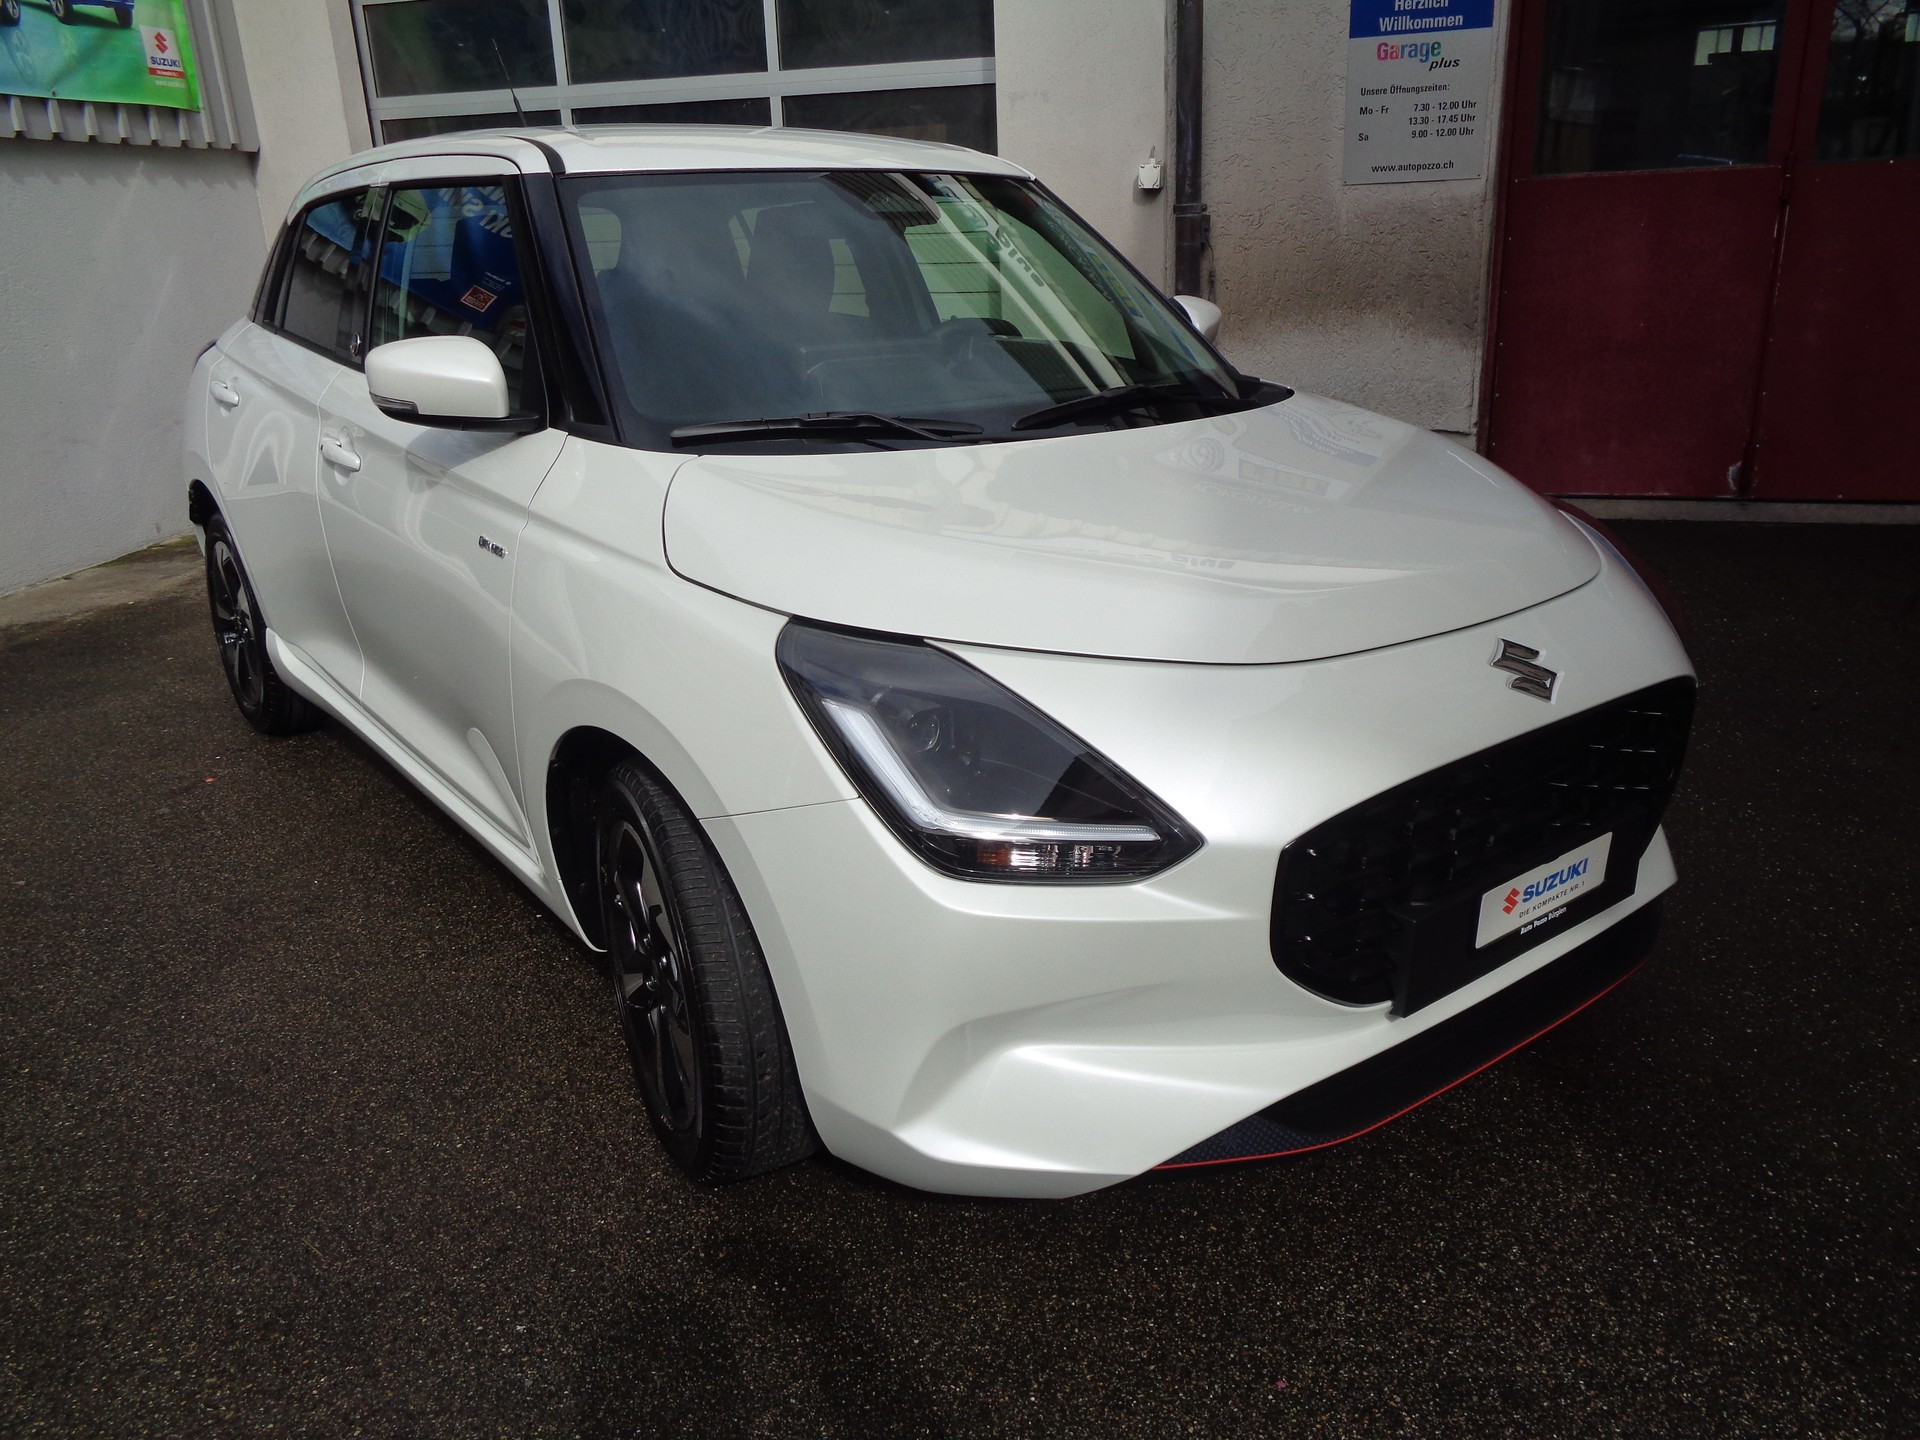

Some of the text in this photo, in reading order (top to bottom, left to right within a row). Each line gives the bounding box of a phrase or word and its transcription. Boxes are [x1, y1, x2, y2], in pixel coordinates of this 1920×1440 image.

[1379, 15, 1463, 32] Willkommen
[1376, 41, 1442, 63] Garage
[150, 56, 180, 67] SUZUKI
[1429, 57, 1461, 71] plus
[1360, 83, 1451, 96] Unsere Öffnungszeiten:
[1359, 107, 1374, 116] Mo
[1380, 106, 1390, 114] Fr
[1413, 103, 1431, 112] 7.30
[1438, 101, 1460, 110] 12.00
[1461, 100, 1478, 109] Uhr
[1408, 117, 1430, 125] 13.30
[1437, 115, 1459, 124] 17.45
[1460, 114, 1476, 122] Uhr
[1358, 133, 1369, 141] Sa
[1411, 130, 1428, 139] 9.00
[1435, 129, 1457, 137] 12.00
[1458, 127, 1475, 136] Uhr
[1371, 160, 1454, 173] www.autopozzo.ch
[1522, 858, 1588, 903] SUZUKI
[1519, 907, 1531, 918] DIE
[1532, 890, 1568, 911] KOMPAKTE
